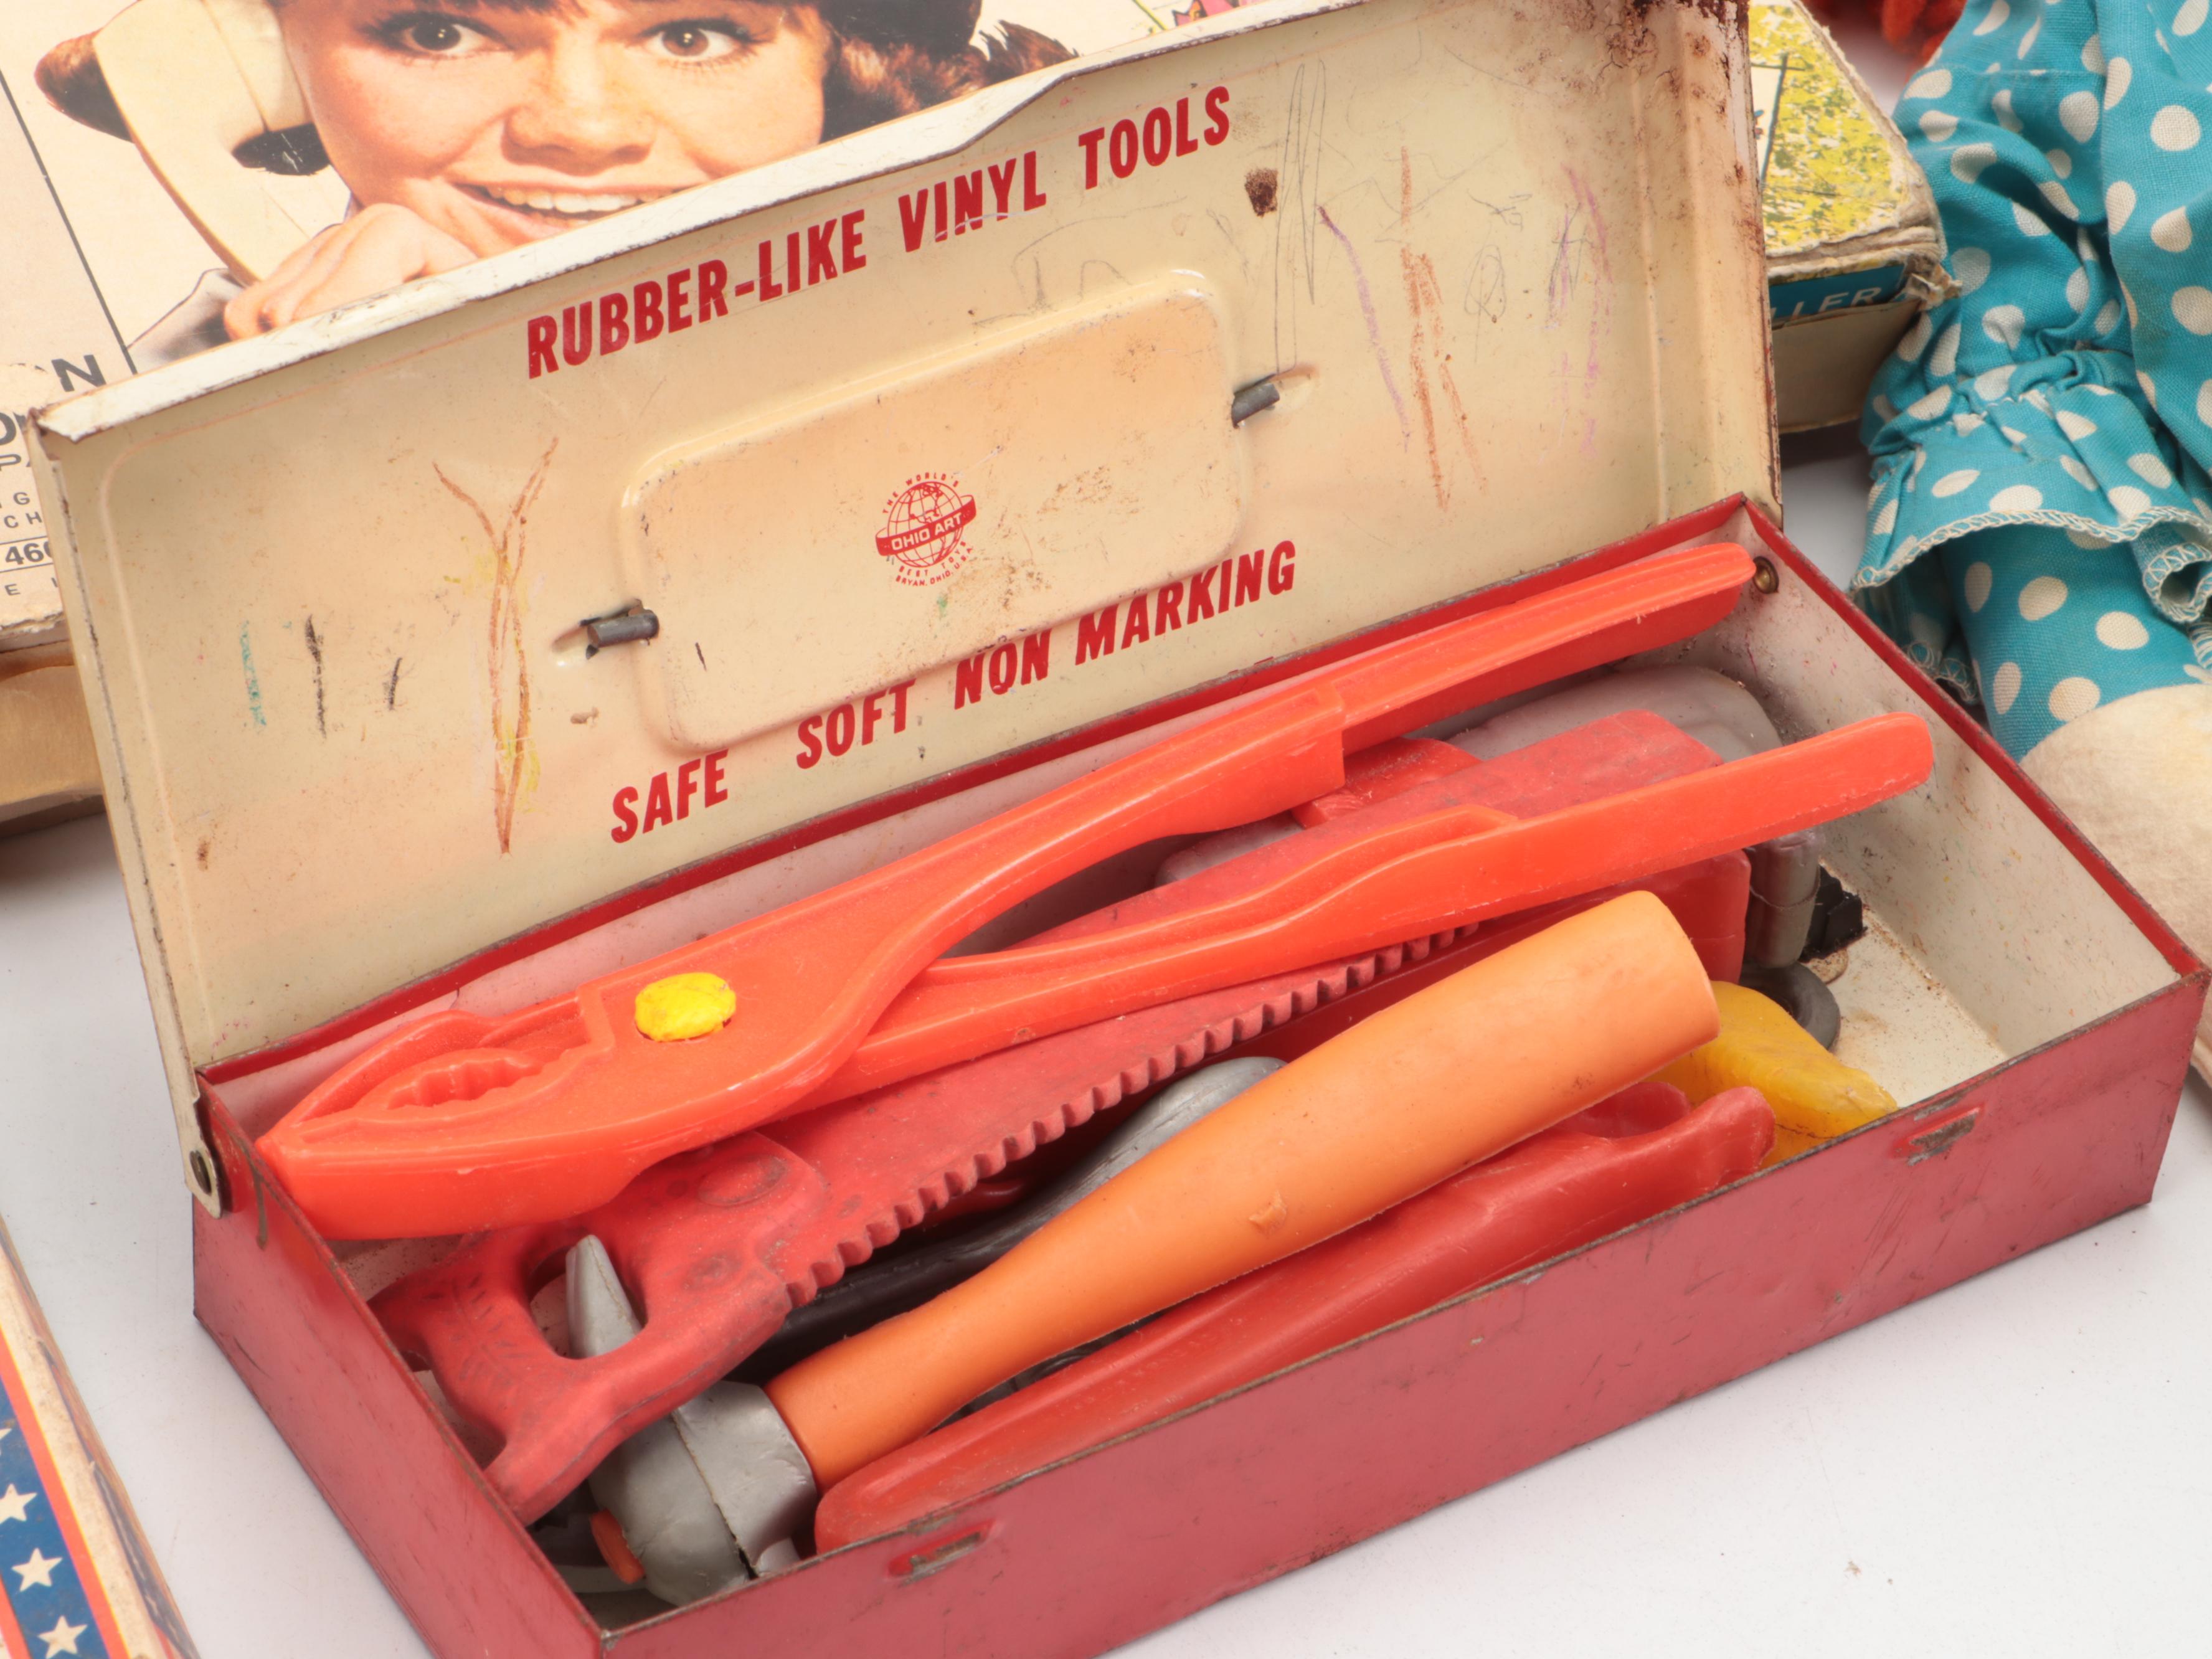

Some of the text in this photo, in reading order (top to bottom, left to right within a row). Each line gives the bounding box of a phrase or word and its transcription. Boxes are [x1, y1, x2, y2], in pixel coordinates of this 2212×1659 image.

[527, 86, 1231, 379] RUBBER-LIKE VINYL TOOLS
[891, 512, 962, 551] OHIO ART
[899, 541, 967, 577] BEST TOYS
[610, 540, 1296, 844] SAFE SOFT NON MARKING
